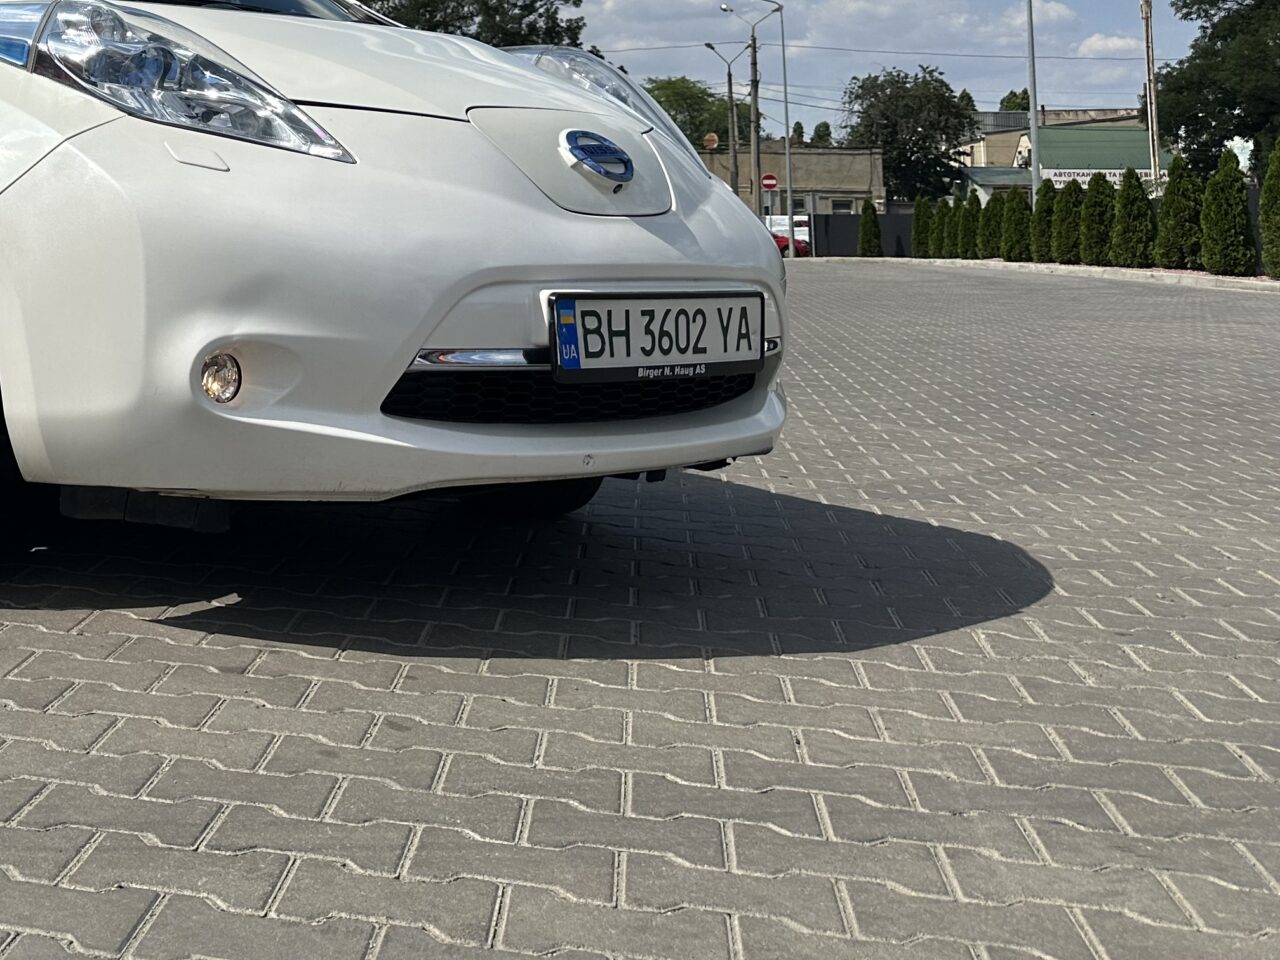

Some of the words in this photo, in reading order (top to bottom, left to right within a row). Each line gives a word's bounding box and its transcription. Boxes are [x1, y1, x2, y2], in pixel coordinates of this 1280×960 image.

[580, 309, 631, 359] BH
[640, 308, 707, 357] 3602
[717, 306, 752, 353] YA
[562, 344, 578, 359] UA
[637, 368, 663, 378] Birger
[664, 366, 673, 376] N.
[674, 365, 694, 376] Haug
[695, 364, 706, 374] AS
